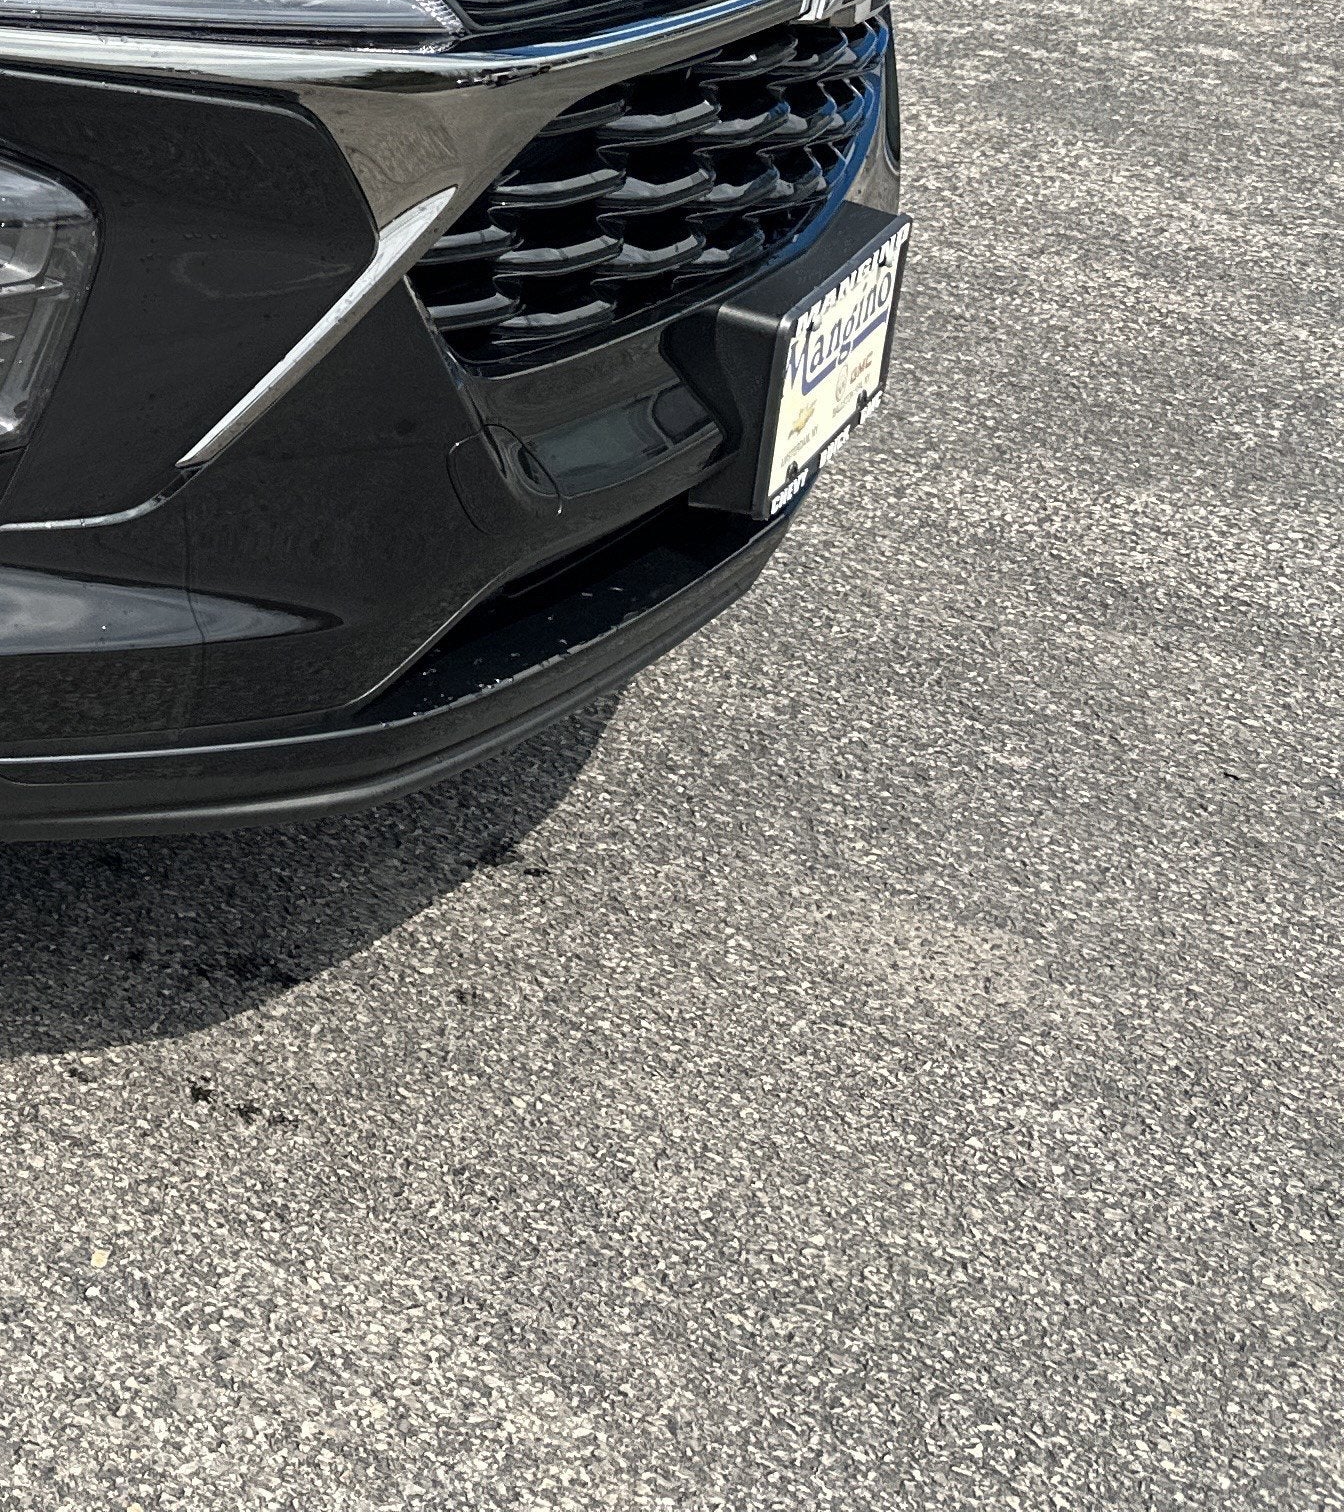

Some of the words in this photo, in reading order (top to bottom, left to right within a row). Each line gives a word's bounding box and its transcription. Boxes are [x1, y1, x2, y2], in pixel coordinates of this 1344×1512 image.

[796, 222, 911, 338] MANGINO
[788, 271, 892, 395] Mangino
[849, 350, 874, 385] GMC
[770, 468, 809, 515] CHEVY
